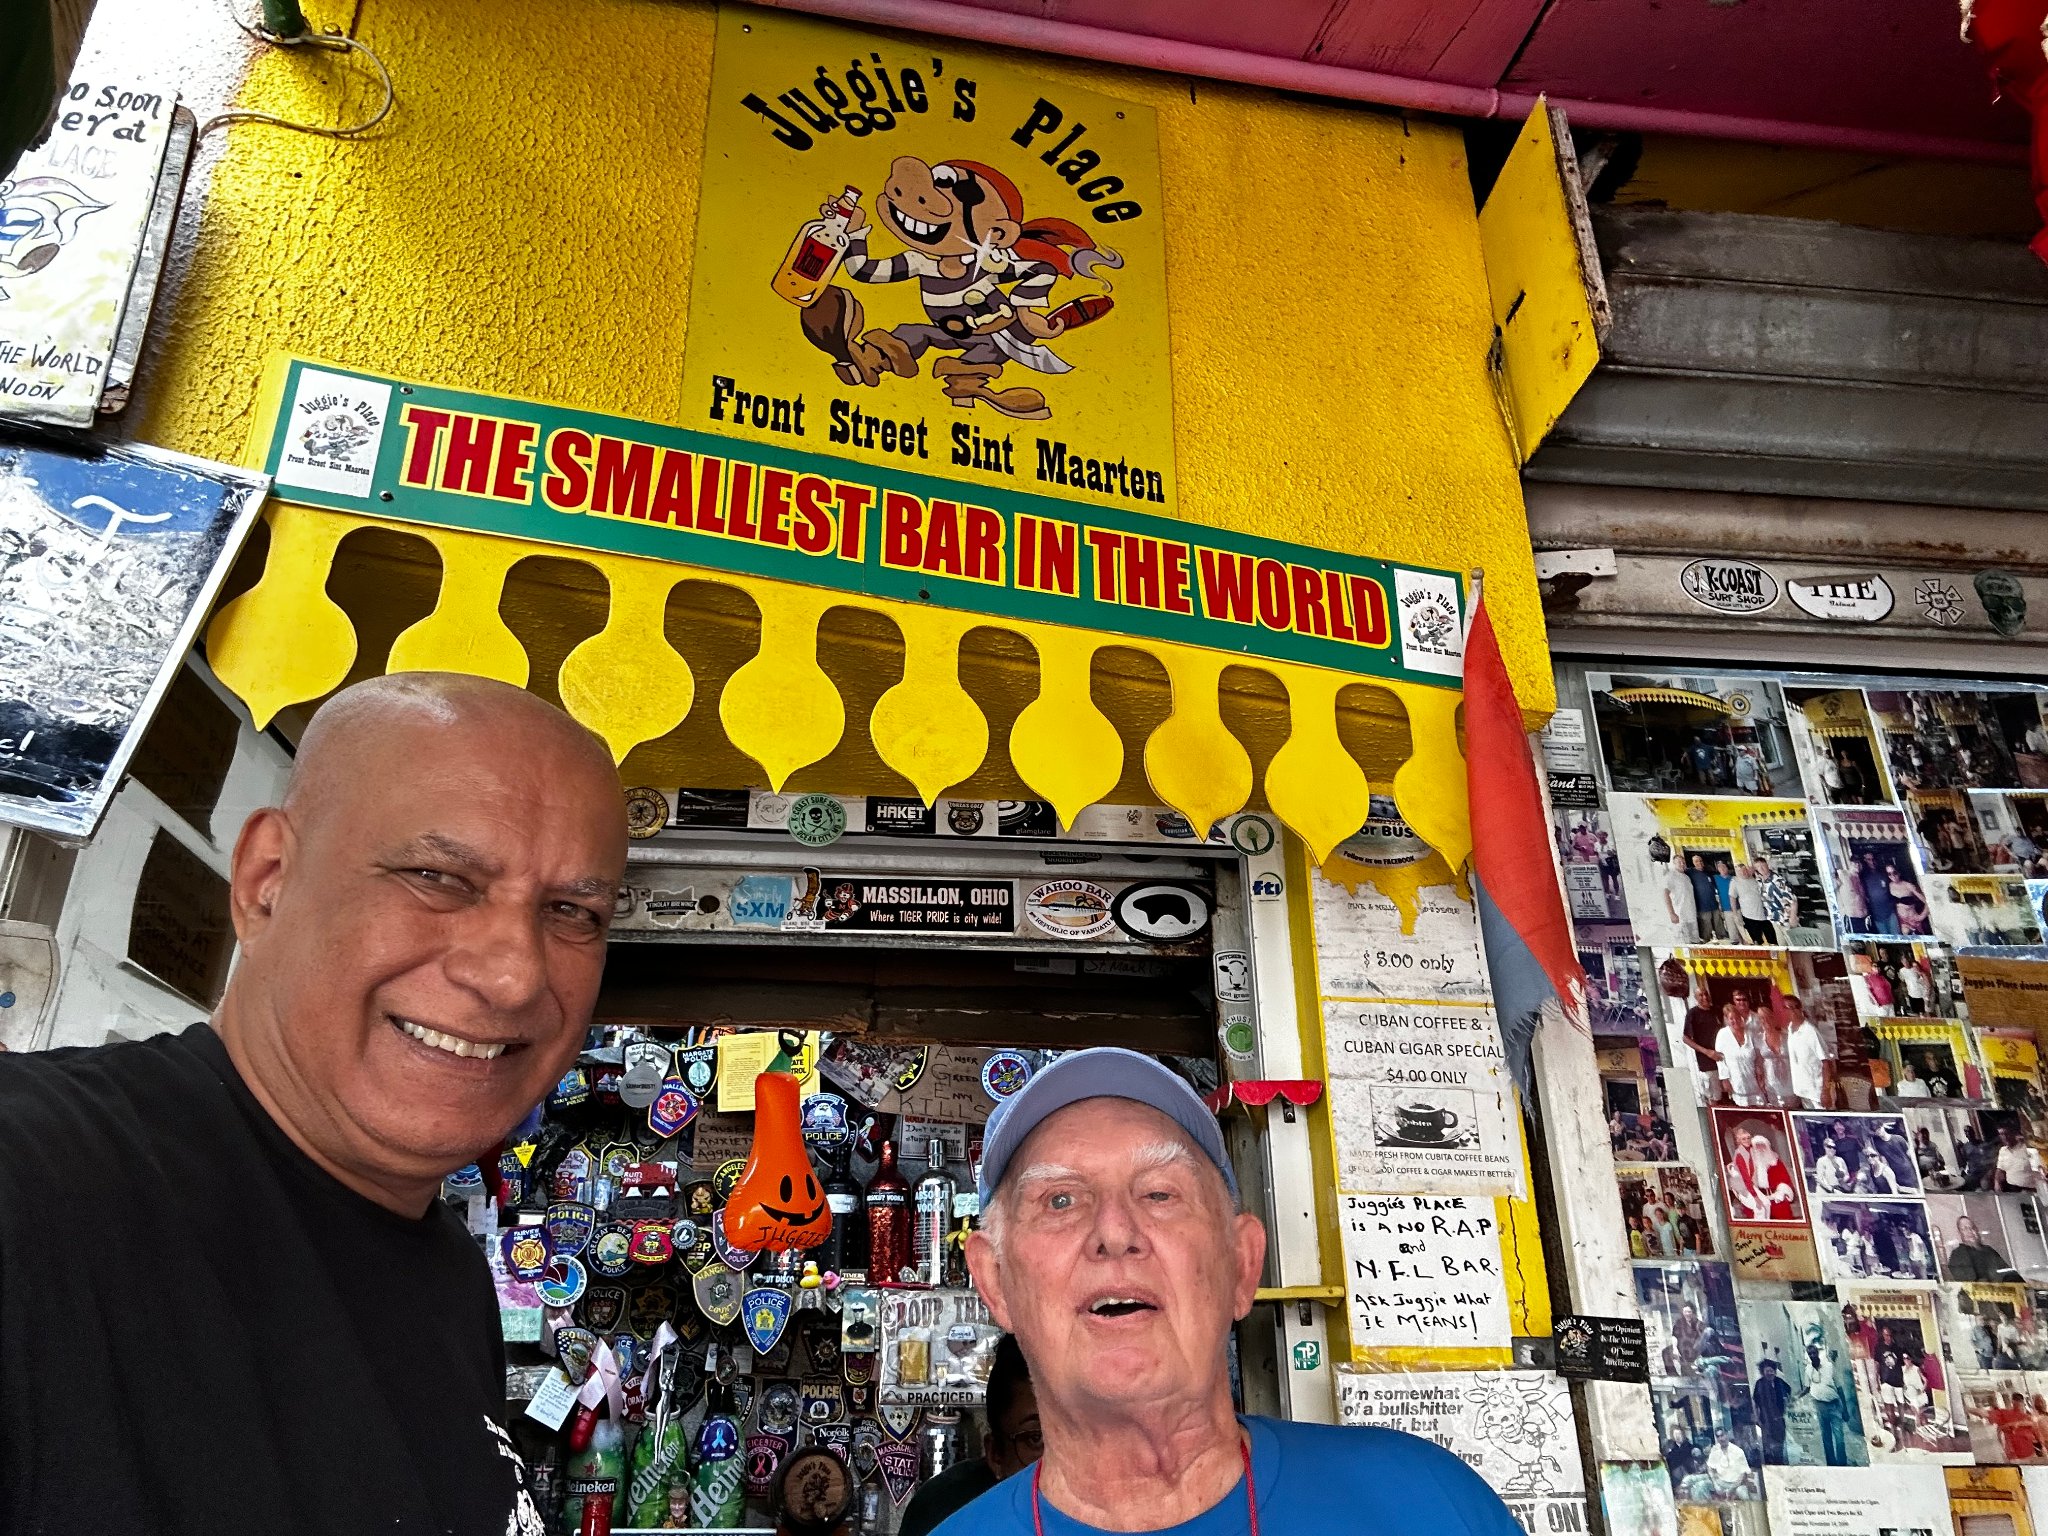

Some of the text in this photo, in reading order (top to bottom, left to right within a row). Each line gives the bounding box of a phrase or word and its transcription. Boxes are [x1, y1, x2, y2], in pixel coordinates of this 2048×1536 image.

[95, 85, 162, 120] soon
[113, 119, 147, 142] at
[740, 52, 1143, 224] Juggie's Place
[31, 343, 103, 376] WORLD
[299, 393, 380, 426] Juggie's Place
[709, 375, 1165, 503] Front Street Sint Maarten
[401, 404, 1390, 648] THE SMALLEST BAR IN THE WORLD
[1704, 565, 1762, 596] K-COAST
[1708, 592, 1765, 605] SURF SHOP
[790, 799, 811, 822] K-COAST
[810, 795, 828, 804] SURF
[827, 800, 842, 815] SHOP
[876, 805, 925, 819] HAKET
[796, 831, 817, 843] OCEAN
[1015, 828, 1051, 836] glamglare
[1343, 851, 1364, 862] Follow
[1384, 856, 1415, 865] FACEBOOK
[862, 886, 1009, 907] MASSILLON, OHIO
[1034, 882, 1112, 904] WAHOO BAR
[735, 902, 785, 919] SXM
[870, 909, 1002, 928] Where TIGER PRIDE is city wide!
[1034, 916, 1069, 936] REPUBLIC
[1081, 919, 1112, 936] VANUATU
[1420, 953, 1455, 974] only
[1222, 1015, 1252, 1029] SCHUST
[1359, 1013, 1482, 1031] CUBAN COFFEE &
[682, 1049, 714, 1058] MARGATE
[1344, 1040, 1505, 1059] CUBAN CIGAR SPECIAL
[684, 1054, 713, 1063] POLICE
[987, 1056, 1000, 1069] COAST
[1001, 1054, 1020, 1062] GUARD
[1386, 1067, 1468, 1084] $4.00 ONLY
[900, 1095, 990, 1123] KILLS
[805, 1132, 842, 1140] POLICE
[1375, 1151, 1510, 1163] FRESH FROM CUBITA COFFEE BEANS
[720, 1163, 746, 1179] ANGELES
[1431, 1168, 1452, 1176] CIGAR
[1453, 1169, 1478, 1177] MAKES
[1415, 1197, 1466, 1211] PLACE
[549, 1211, 592, 1222] POLICE
[513, 1228, 540, 1237] FAIRVIEW
[1352, 1221, 1366, 1232] is
[1378, 1222, 1391, 1234] A
[1397, 1221, 1425, 1234] NO
[589, 1226, 632, 1255] DELRAY BEA
[1735, 1229, 1809, 1244] Merry Christmas
[1399, 1240, 1426, 1254] and
[728, 1255, 750, 1263] POLICE
[601, 1263, 627, 1274] POLICE
[774, 1274, 794, 1284] DISCO
[588, 1289, 621, 1300] POLICE
[708, 1299, 738, 1314] COUNTY
[748, 1298, 785, 1309] POLICE
[1355, 1292, 1492, 1313] Ask Juggie What
[1600, 1322, 1641, 1334] Your Opinion
[1600, 1334, 1642, 1345] Is The Mirror
[1610, 1346, 1634, 1356] Of Your
[802, 1384, 840, 1399] POLICE
[907, 1392, 974, 1403] PRACTICED
[1342, 1386, 1460, 1401] I'm somewhat
[1344, 1402, 1463, 1416] of a bullshitter
[1411, 1418, 1439, 1432] but
[819, 1427, 850, 1441] Norfolk
[746, 1438, 783, 1451] EICESTER
[691, 1450, 748, 1529] Heinek
